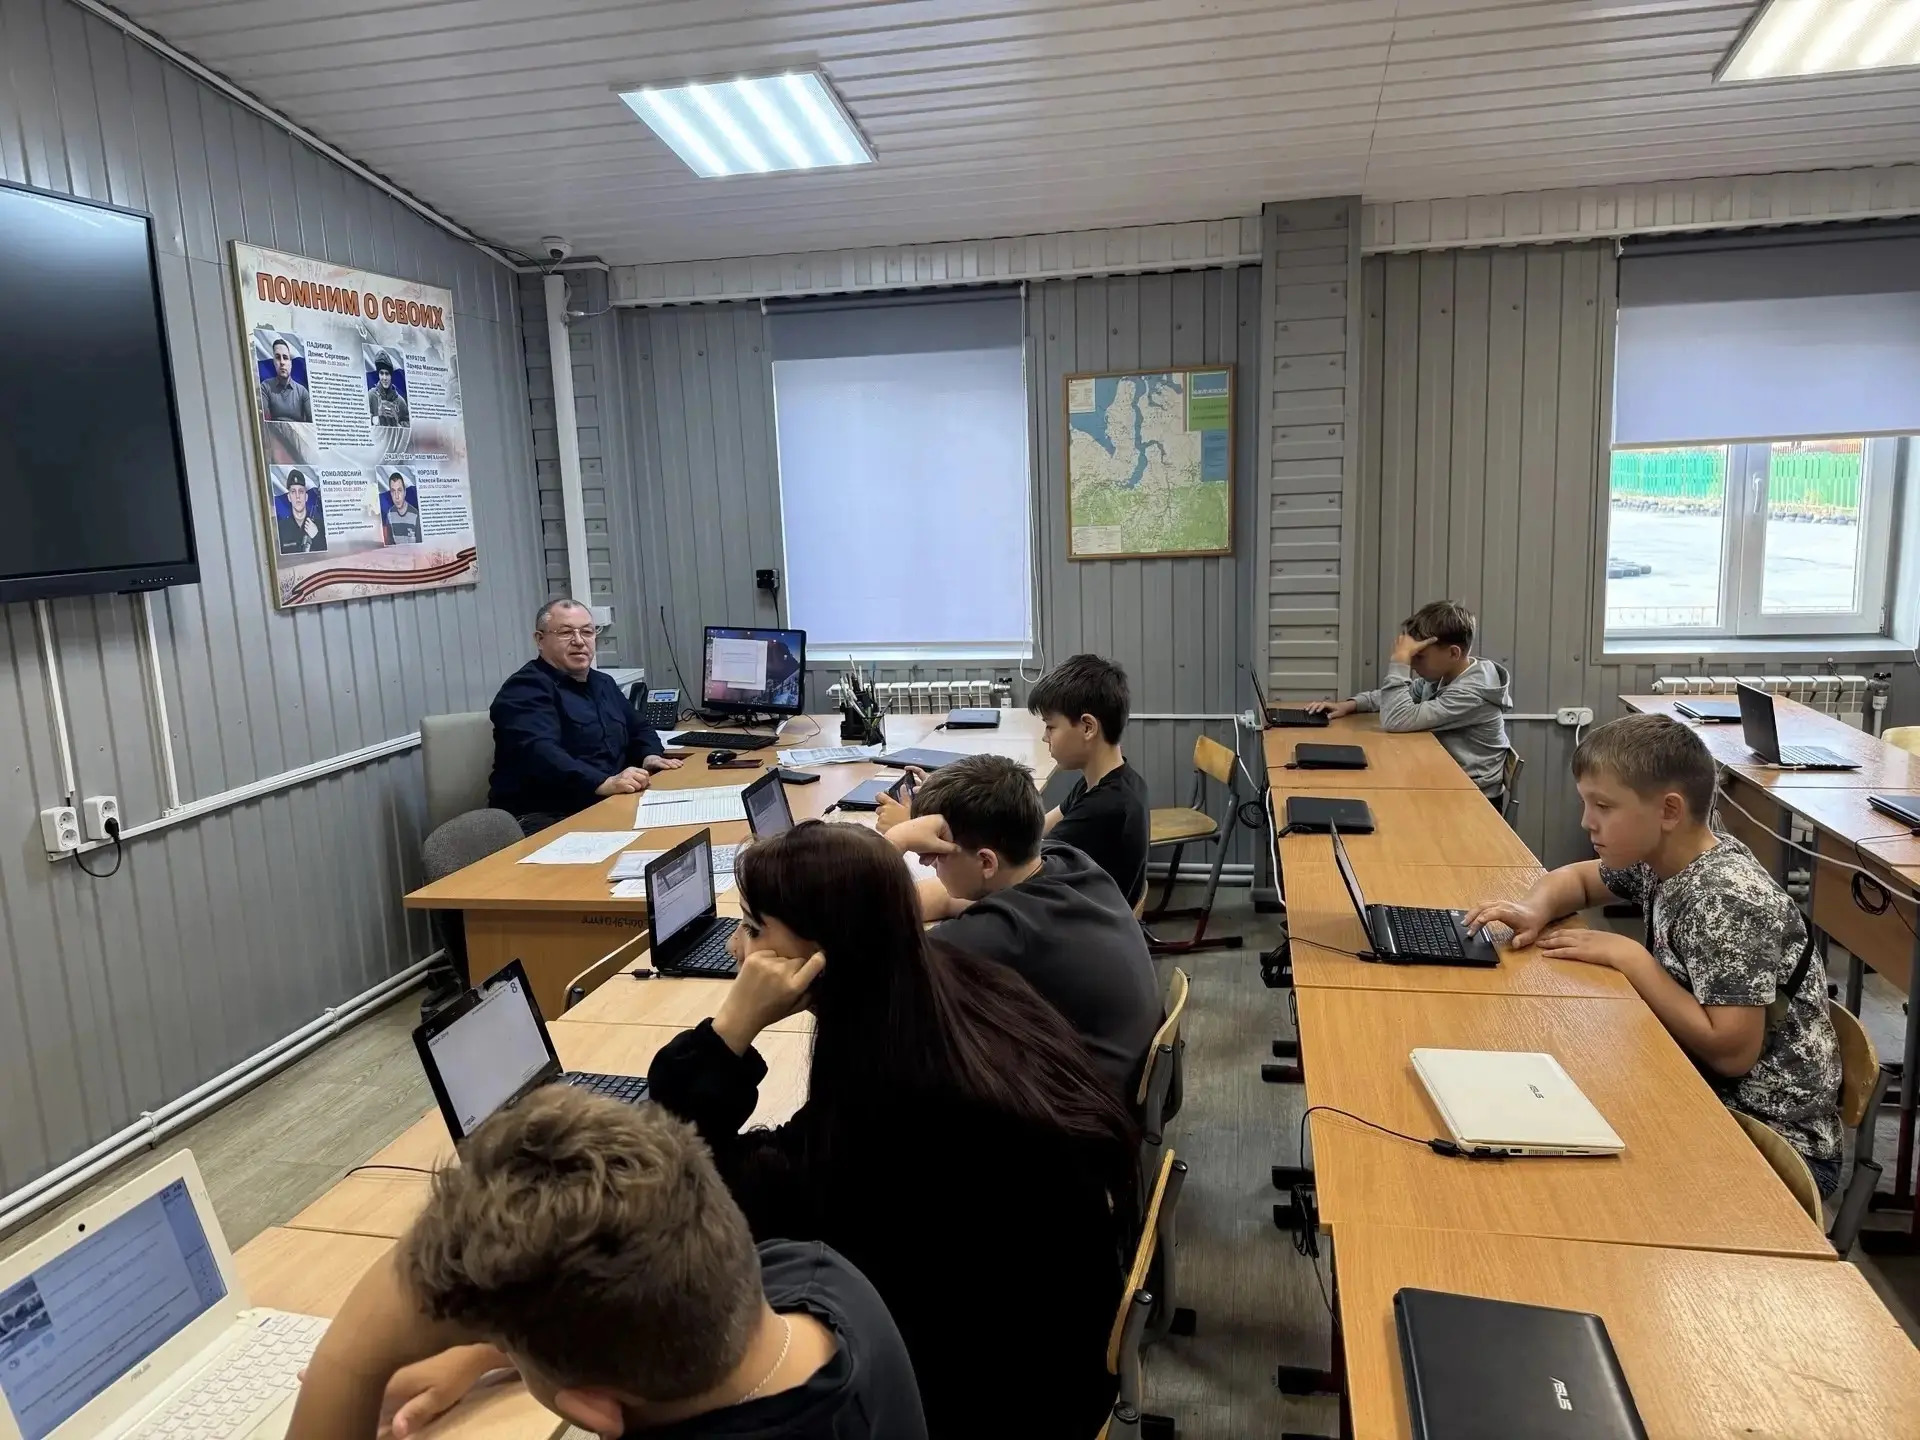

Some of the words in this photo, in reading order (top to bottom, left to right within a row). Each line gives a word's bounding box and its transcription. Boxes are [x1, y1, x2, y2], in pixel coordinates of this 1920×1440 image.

[256, 271, 360, 317] ПОМНИМ
[363, 292, 378, 319] О
[382, 296, 444, 331] СВОИХ
[307, 349, 324, 358] Денис
[324, 351, 350, 361] Сергеевич
[321, 469, 362, 477] СОКОЛОВСКИЙ
[342, 479, 368, 487] Сергеевич
[509, 981, 518, 994] 8
[1548, 1375, 1573, 1411] ASUS
